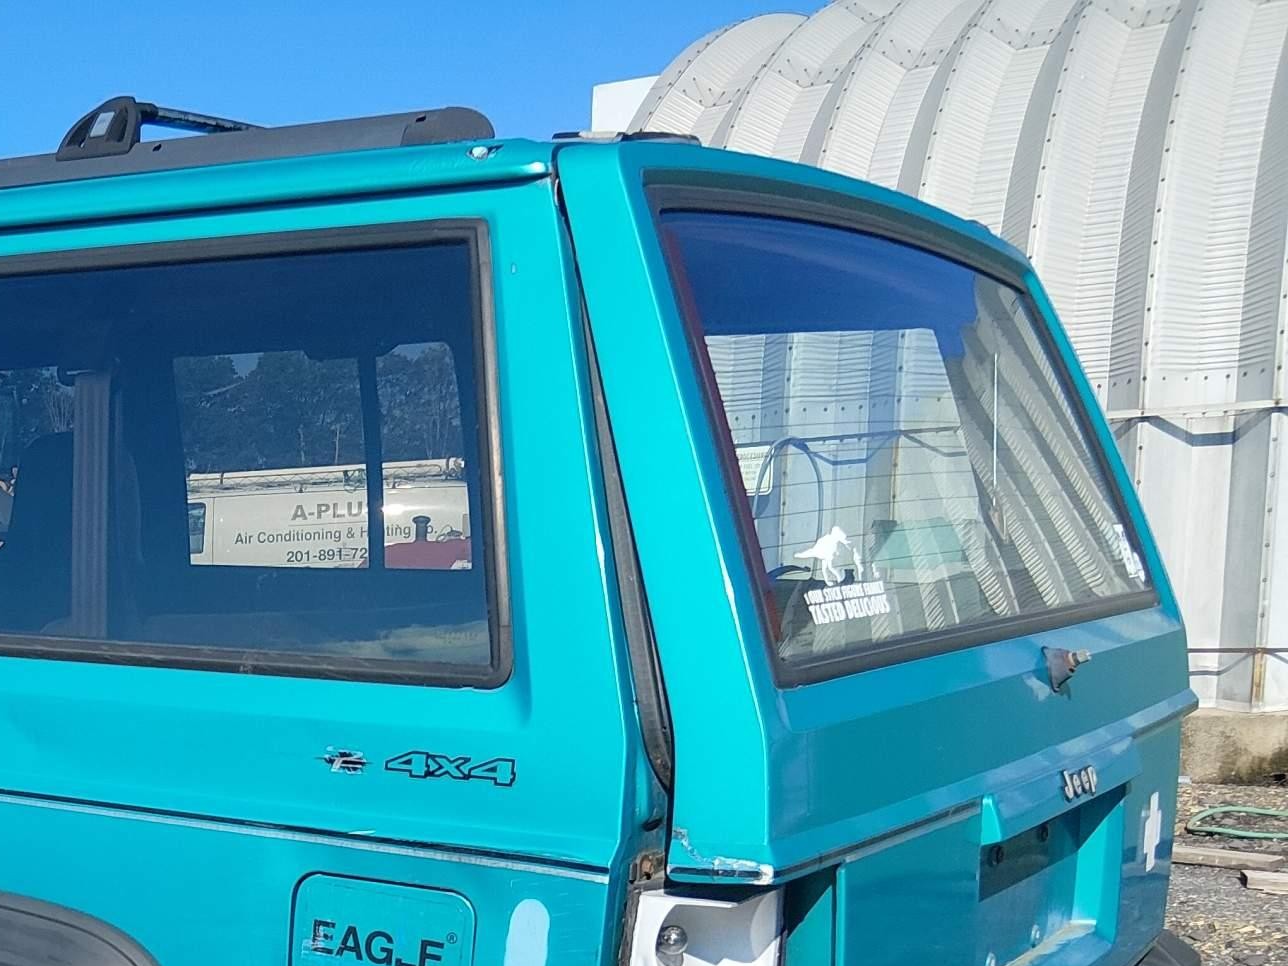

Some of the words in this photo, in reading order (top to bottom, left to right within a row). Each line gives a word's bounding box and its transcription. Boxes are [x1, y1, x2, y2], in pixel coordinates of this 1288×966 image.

[291, 501, 368, 521] A-PLU
[235, 533, 253, 544] Air
[257, 526, 342, 544] Conditioning
[346, 527, 355, 539] &
[360, 524, 411, 539] Hting
[286, 547, 368, 563] 201-891-72
[808, 602, 846, 625] TASTED
[844, 594, 891, 619] DELICIOUS
[1063, 766, 1097, 800] Jeep
